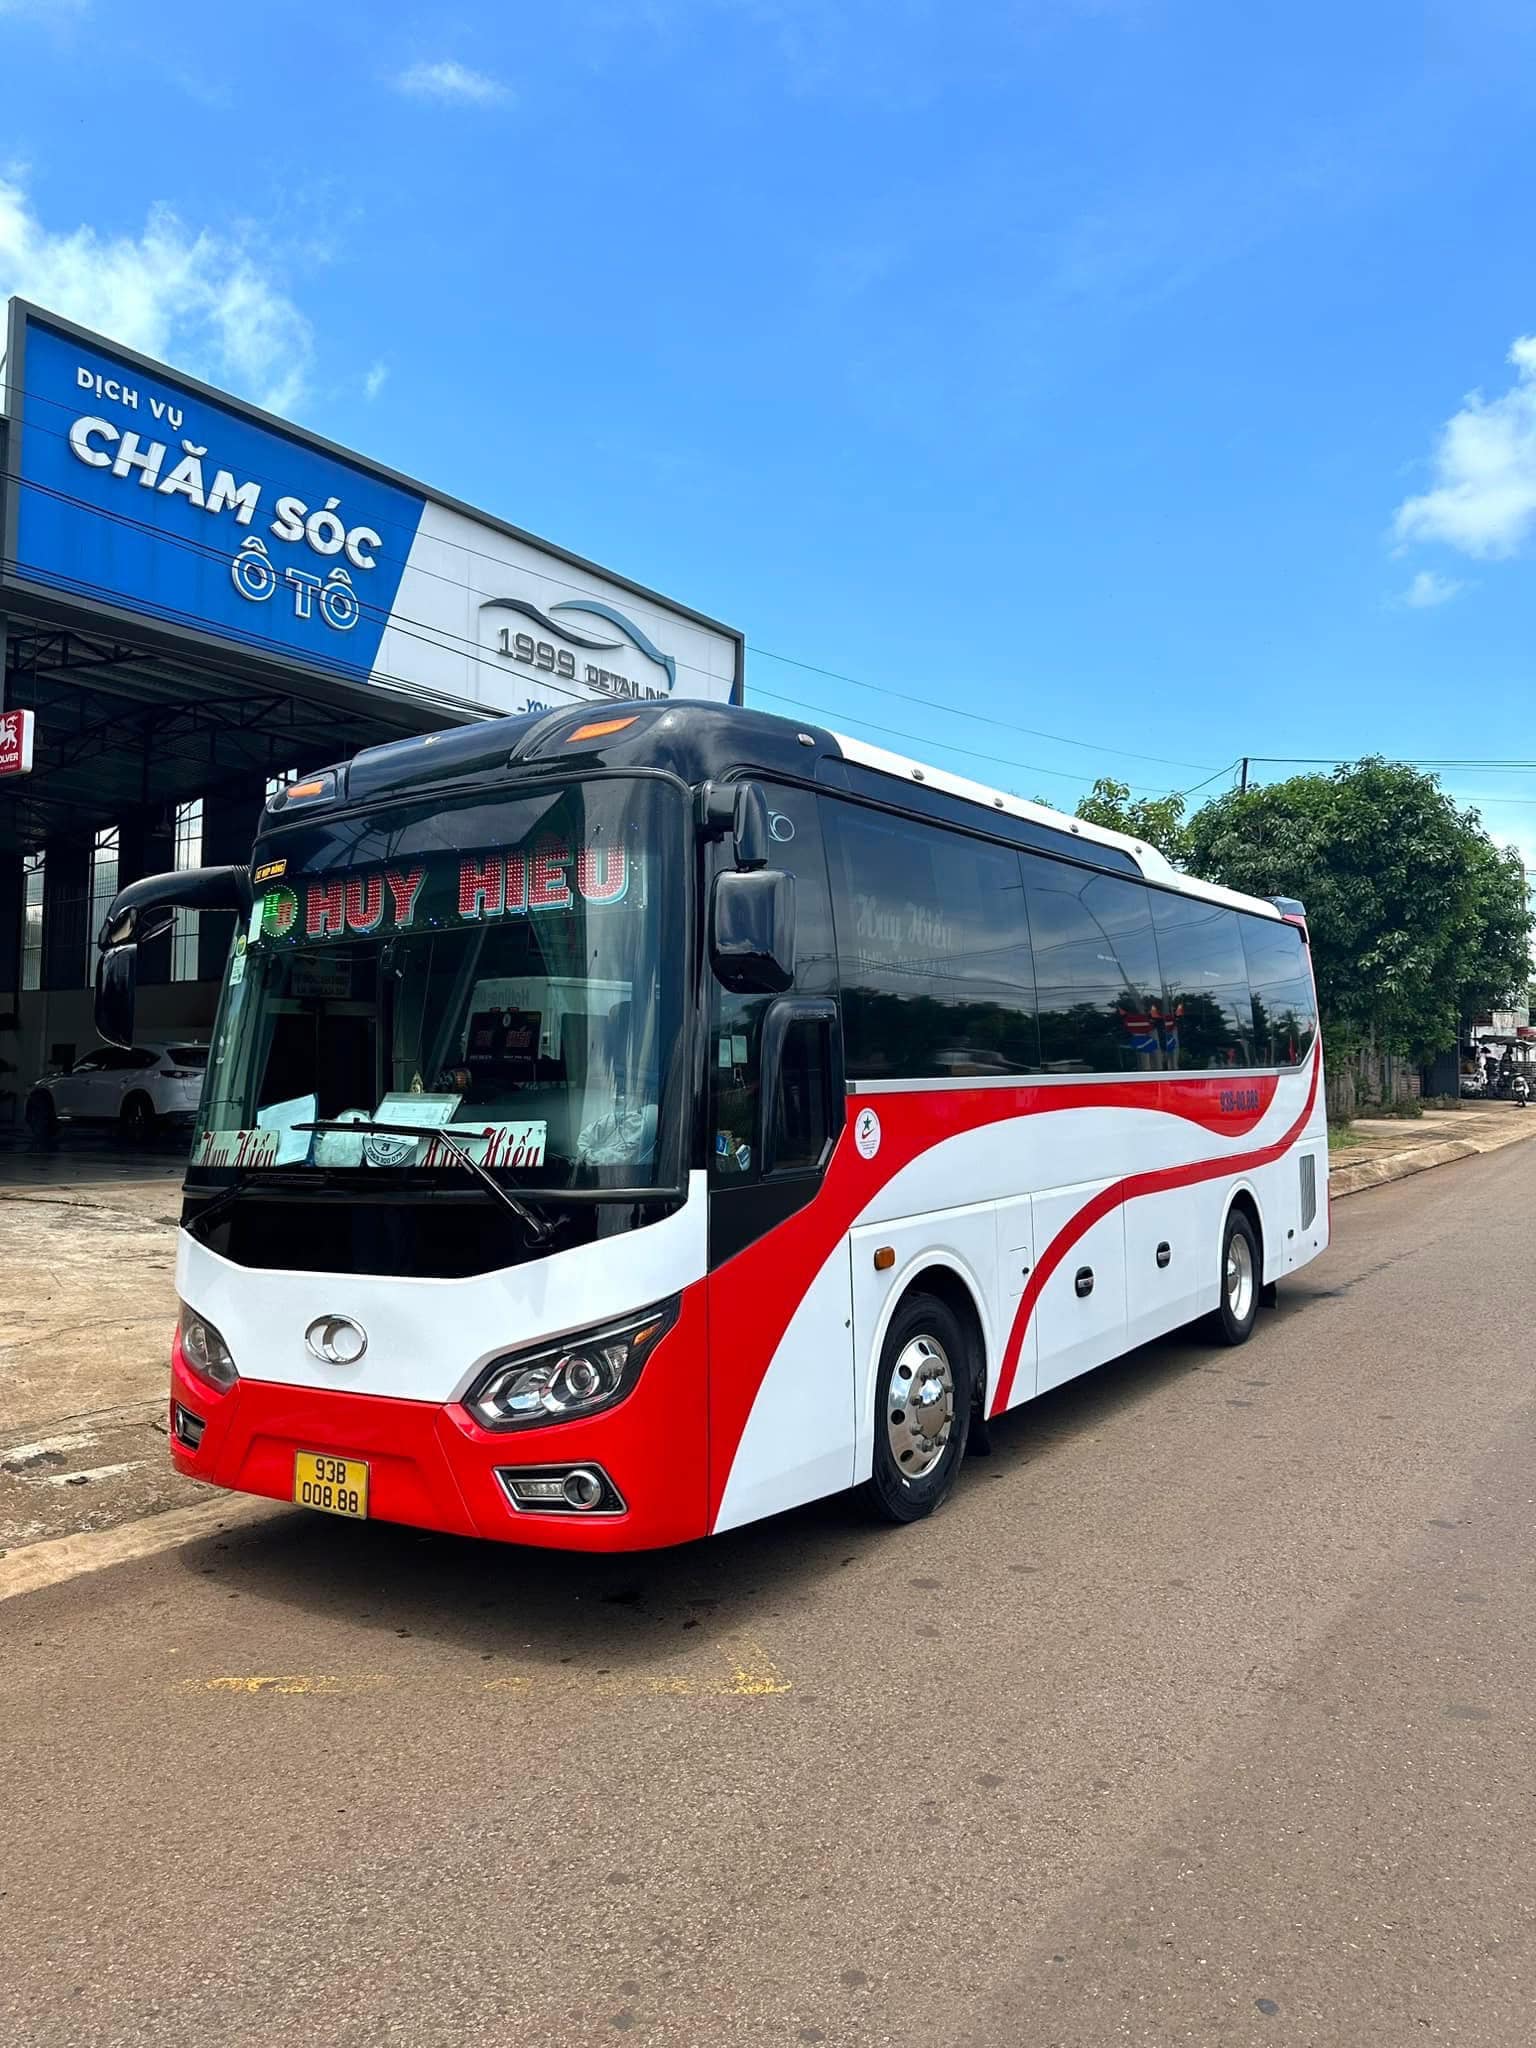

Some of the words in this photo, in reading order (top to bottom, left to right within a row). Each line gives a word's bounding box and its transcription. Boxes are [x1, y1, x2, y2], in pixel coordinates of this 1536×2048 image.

[76, 366, 138, 409] DỊCH
[149, 397, 183, 431] VỤ
[69, 415, 262, 525] CHĂM
[270, 496, 383, 569] SÓC
[231, 536, 276, 602] Ô
[285, 567, 360, 630] TÔ
[499, 628, 575, 679] 1999
[306, 867, 427, 938] HUY
[303, 1482, 358, 1513] 008.88
[315, 1458, 346, 1484] 93B
